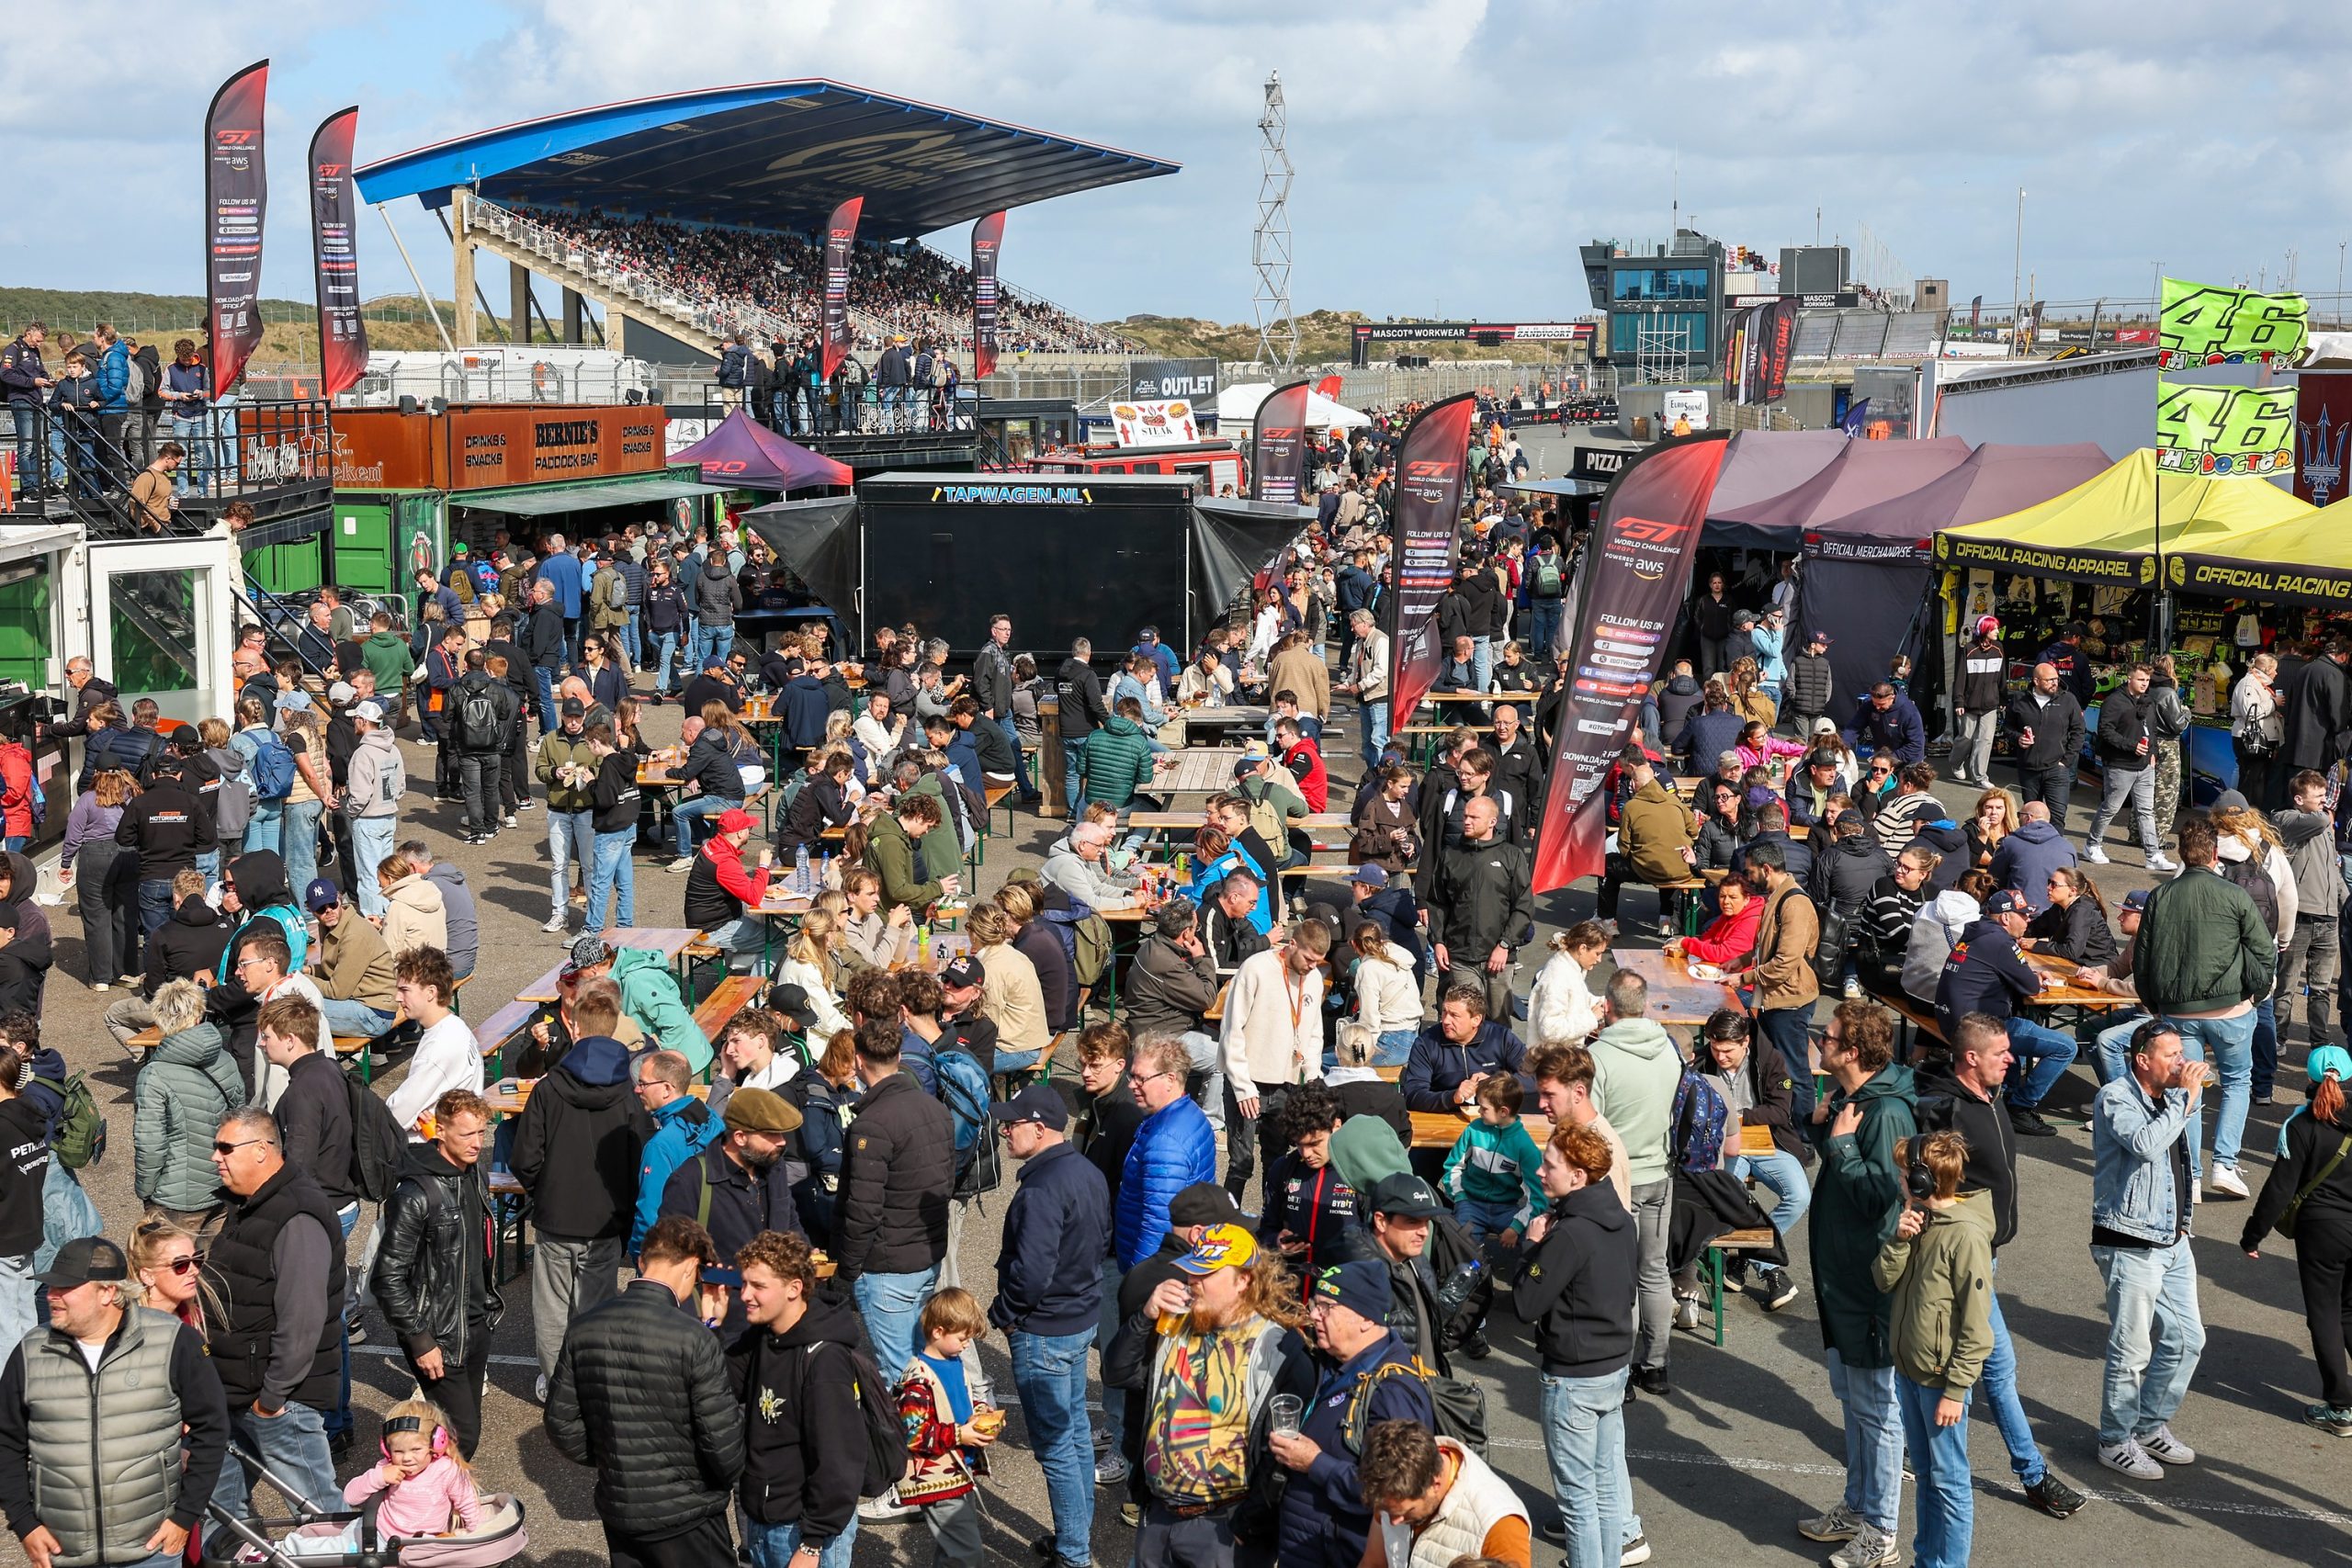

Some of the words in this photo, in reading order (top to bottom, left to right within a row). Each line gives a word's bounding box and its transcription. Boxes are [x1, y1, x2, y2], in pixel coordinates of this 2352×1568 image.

[232, 156, 248, 164] aws
[2160, 288, 2308, 353] 46
[1415, 328, 1465, 337] WORKWEAR
[1517, 330, 1572, 338] ZANDVOORT
[1773, 316, 1792, 386] WELCOME
[1161, 375, 1214, 396] OUTLET
[2157, 387, 2297, 454] 46
[536, 420, 598, 447] BERNIE'S
[623, 426, 649, 438] DRINKS
[1141, 426, 1173, 436] STEAK
[466, 435, 499, 448] DRINKS
[623, 442, 651, 455] SNACKS
[466, 453, 503, 467] SNACKS
[536, 454, 579, 470] PADDOCK
[581, 453, 598, 466] BAR
[1586, 452, 1623, 471] PIZZA
[2199, 448, 2293, 475] DOCTOR
[944, 486, 1084, 504] TAPWAGEN.NL
[1423, 489, 1442, 498] aws
[1407, 530, 1432, 538] FOLLOW
[1433, 530, 1442, 538] US
[1613, 516, 1691, 543] GT
[1607, 543, 1635, 554] EUROPE
[1614, 537, 1641, 548] WORLD
[1642, 542, 1681, 555] CHALLENGE
[1823, 541, 1854, 557] OFFICIAL
[1854, 544, 1911, 558] MERCHANDISE
[1604, 552, 1634, 563] POWERED
[1955, 541, 2009, 562] OFFICIAL
[2009, 548, 2066, 570] RACING
[2065, 558, 2132, 578] APPAREL
[1635, 558, 1665, 573] aws
[2195, 565, 2273, 591] OFFICIAL
[2274, 575, 2351, 598] RACING
[1600, 614, 1638, 627] FOLLOW
[1639, 620, 1653, 629] US
[1363, 646, 1373, 660] N
[1331, 1199, 1353, 1209] BYBIT
